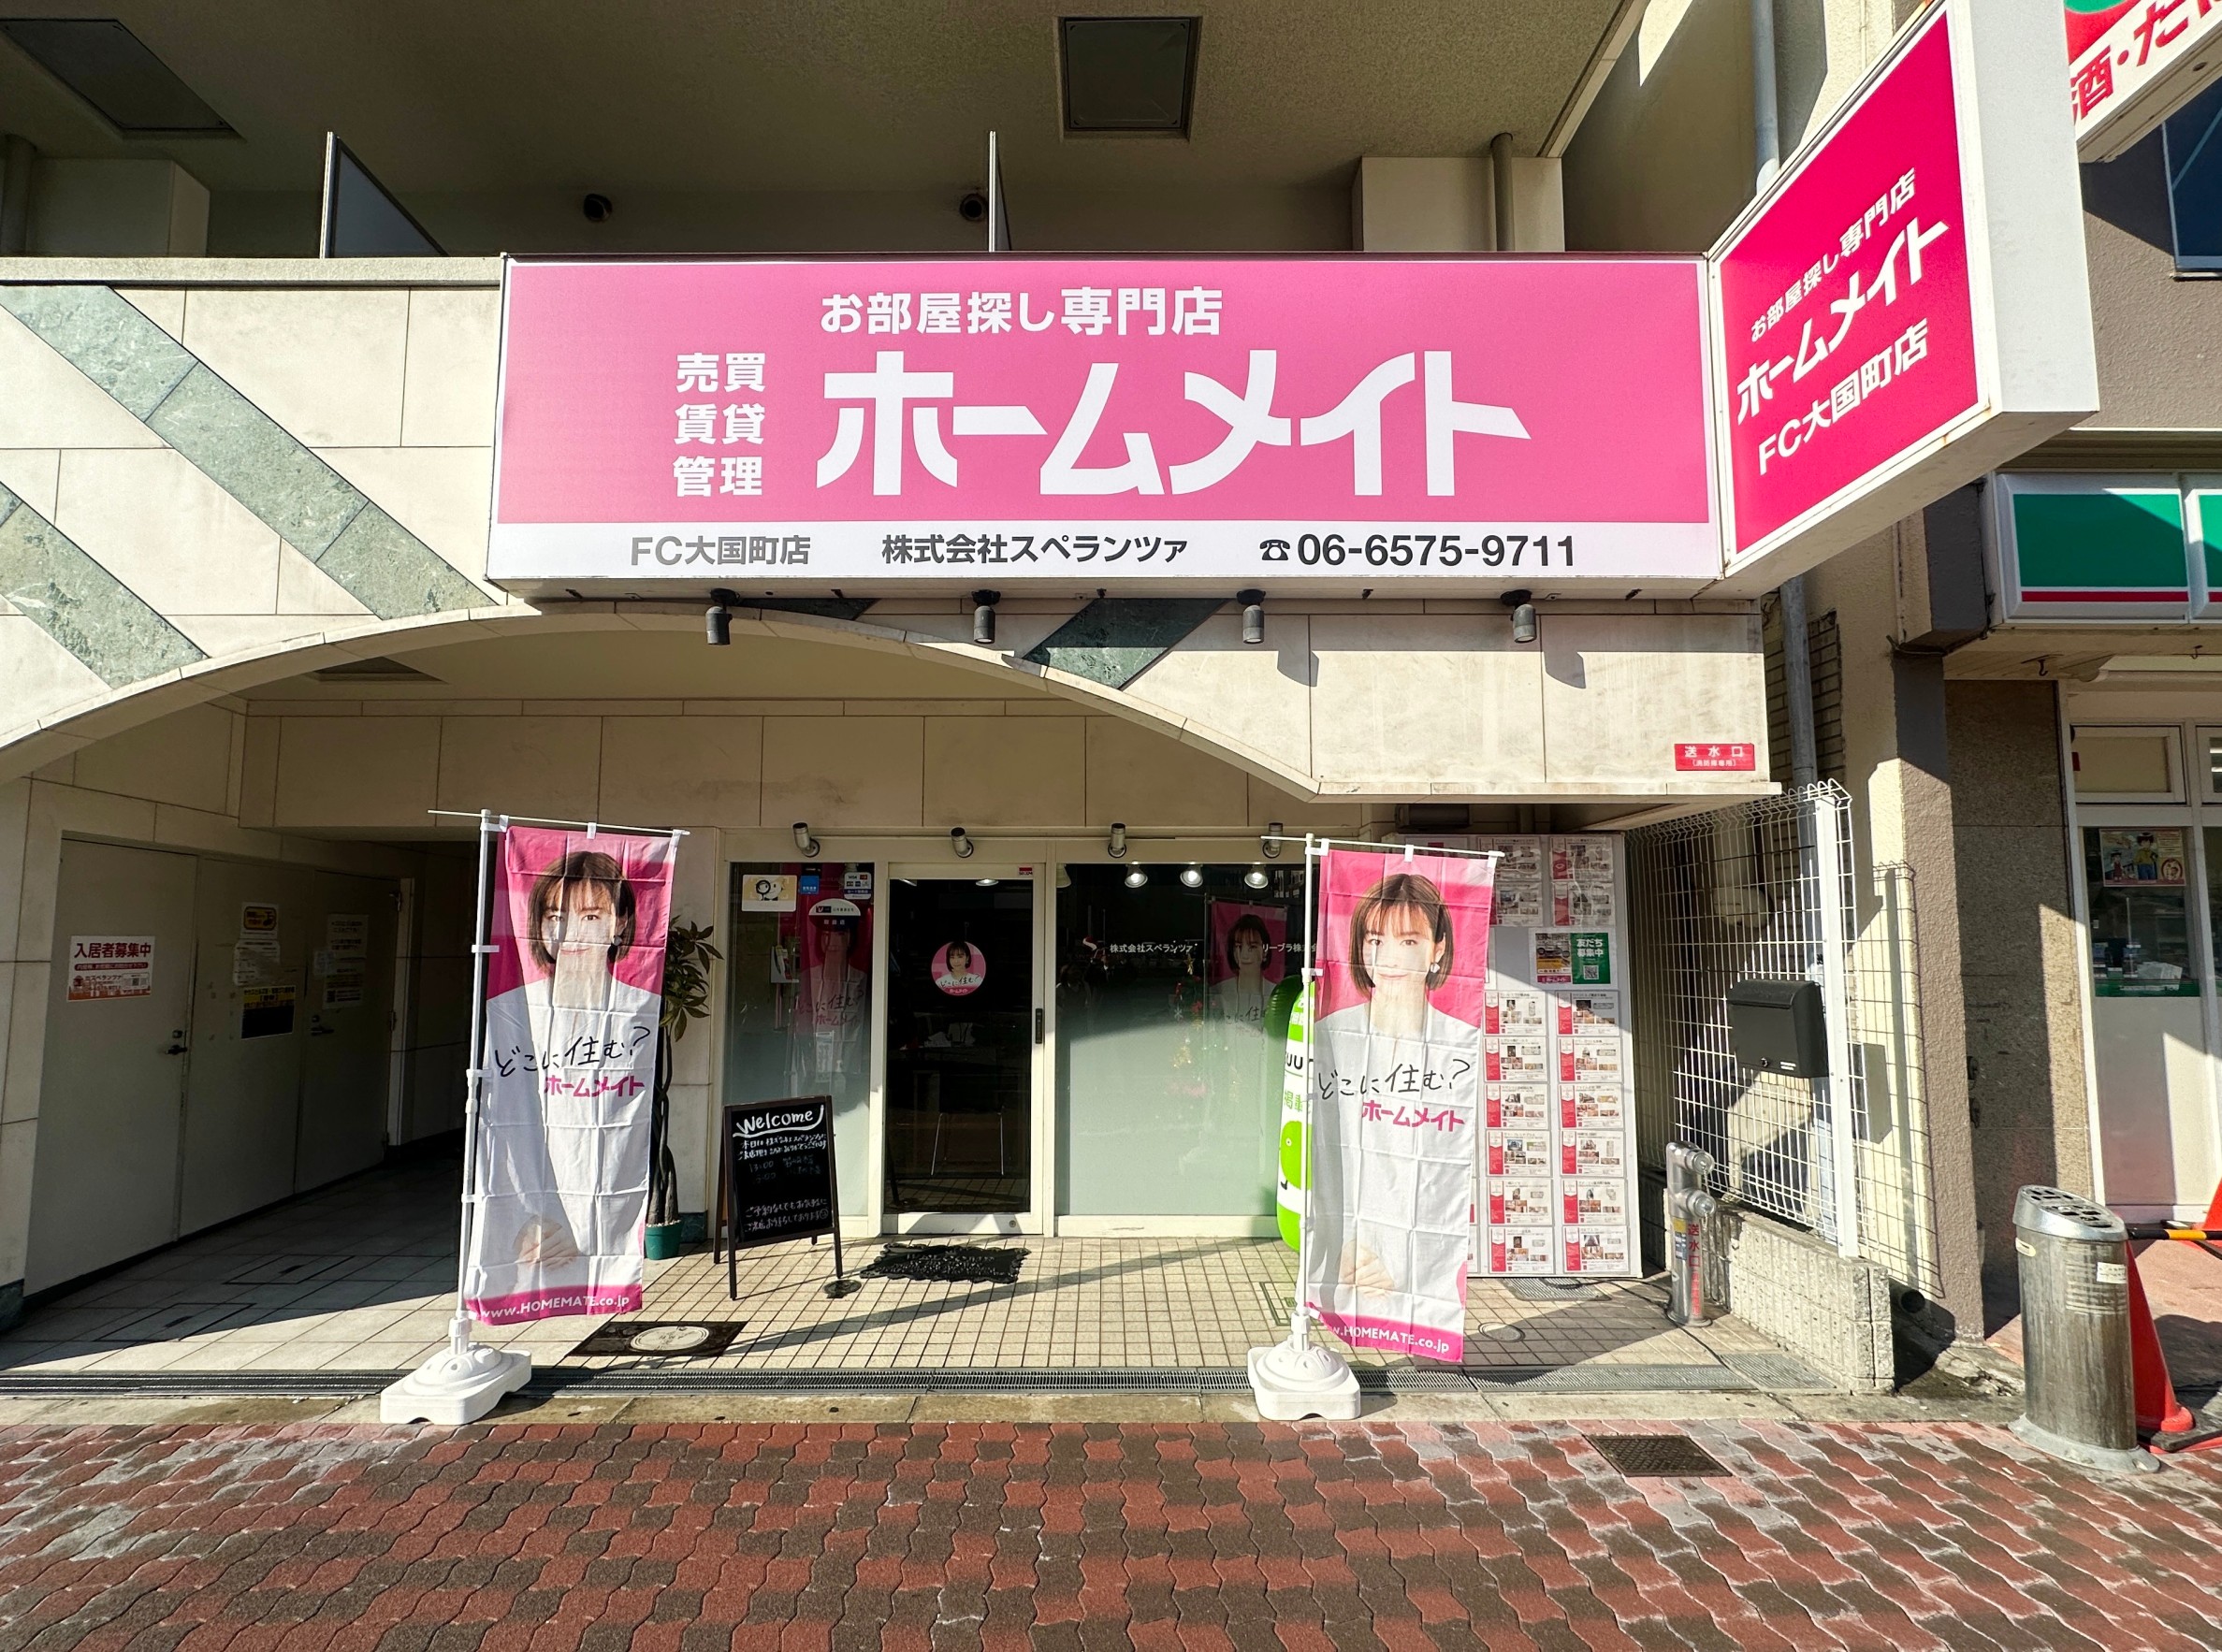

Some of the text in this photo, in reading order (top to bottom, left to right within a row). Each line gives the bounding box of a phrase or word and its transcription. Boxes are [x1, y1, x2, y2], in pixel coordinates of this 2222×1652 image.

[2070, 0, 2222, 125] 酒・た
[1750, 167, 1915, 342] お部屋探し専門店
[820, 286, 1223, 336] お部屋探し専門店
[1737, 217, 1949, 425] ホームメイト
[675, 353, 766, 393] 売買
[1759, 318, 1929, 475] FC大国町店
[674, 403, 765, 445] 賃貸
[816, 350, 1531, 496] ホームメイト
[673, 456, 762, 497] 管理
[631, 534, 811, 566] FC大国町店
[881, 533, 1188, 564] 株式会社スペランツァ
[1297, 534, 1575, 566] 06-6575-9711
[1685, 746, 1744, 758] 送水口
[74, 942, 152, 958] 入居者募集中
[495, 1026, 650, 1077] どこに住む?
[545, 1075, 645, 1098] ホームメイト
[1318, 1059, 1471, 1100] どこに住む?
[736, 1109, 814, 1135] Welcome
[1361, 1099, 1465, 1132] ホームメイト
